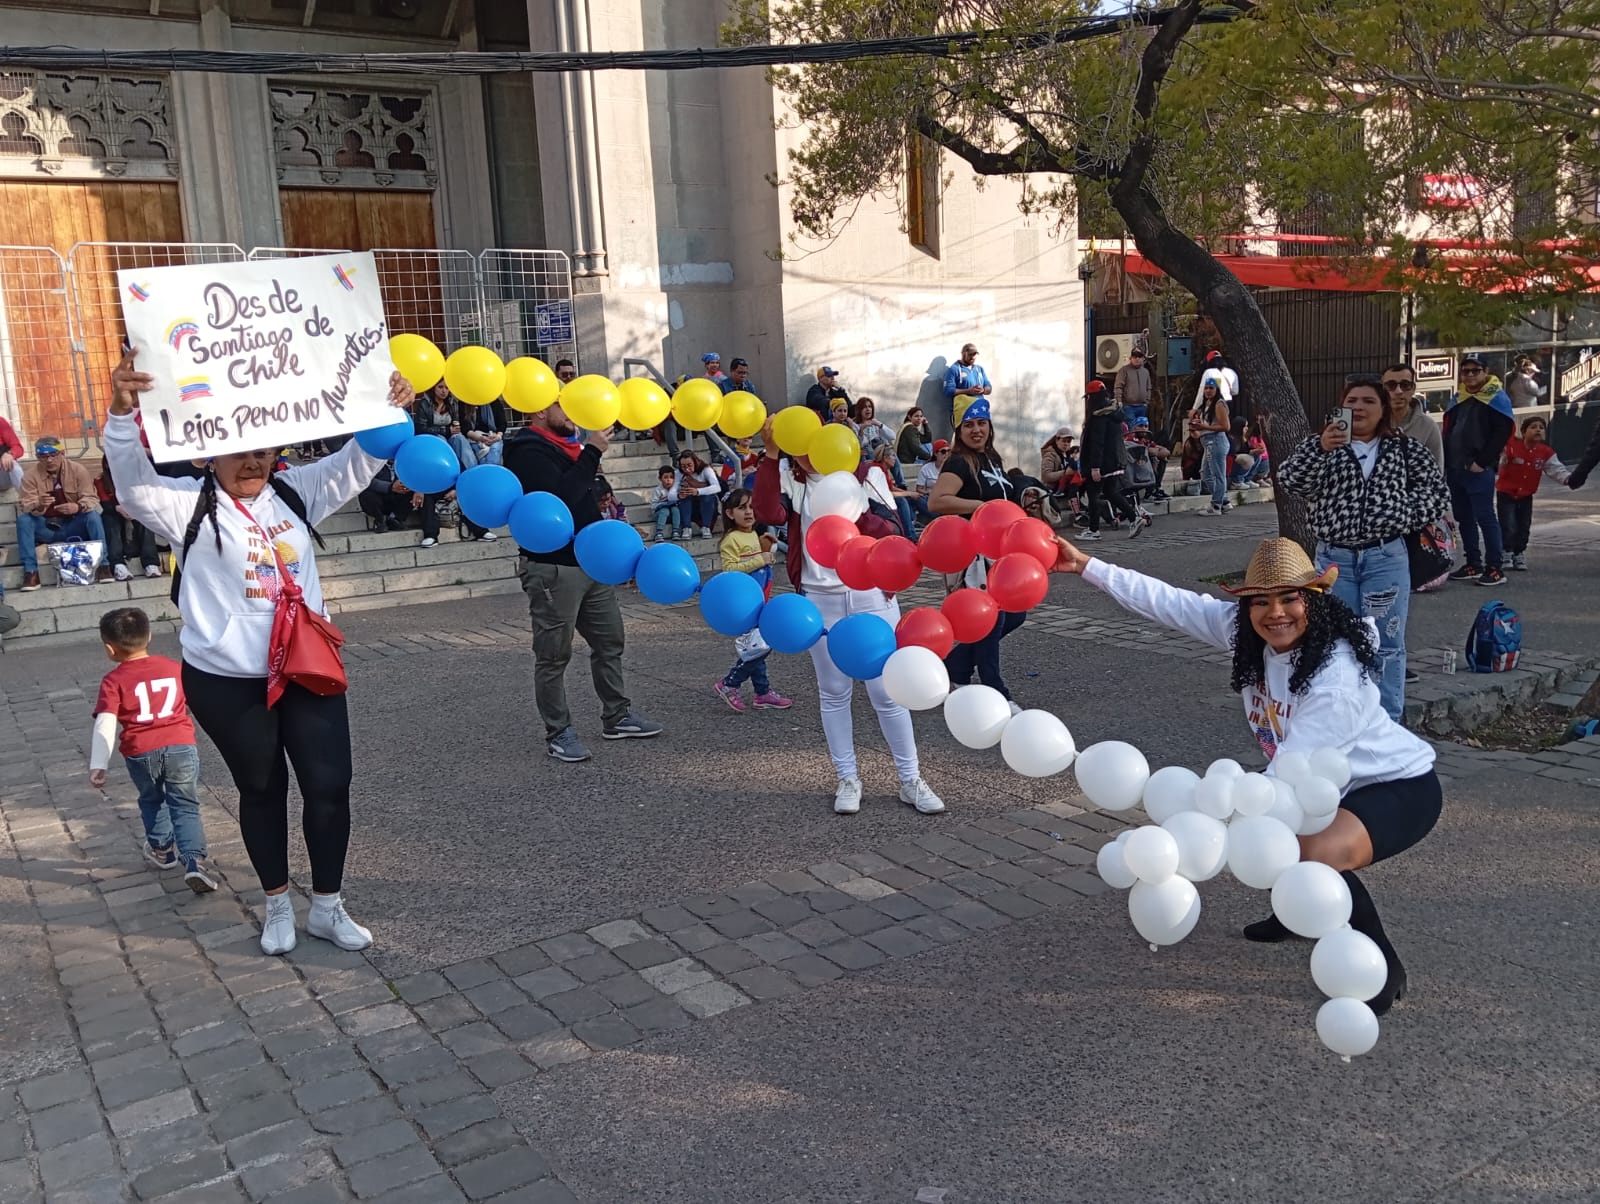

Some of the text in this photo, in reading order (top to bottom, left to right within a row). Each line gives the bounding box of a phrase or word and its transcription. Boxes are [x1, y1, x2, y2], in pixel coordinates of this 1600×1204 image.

[188, 305, 335, 365] Santiago de
[227, 343, 305, 389] Chile
[1420, 361, 1449, 375] Delivery
[1561, 360, 1590, 396] DOMANI
[160, 409, 229, 451] Lejos
[247, 551, 259, 562] IN
[245, 587, 269, 599] DNA
[134, 677, 178, 722] 17
[1248, 710, 1261, 725] IN
